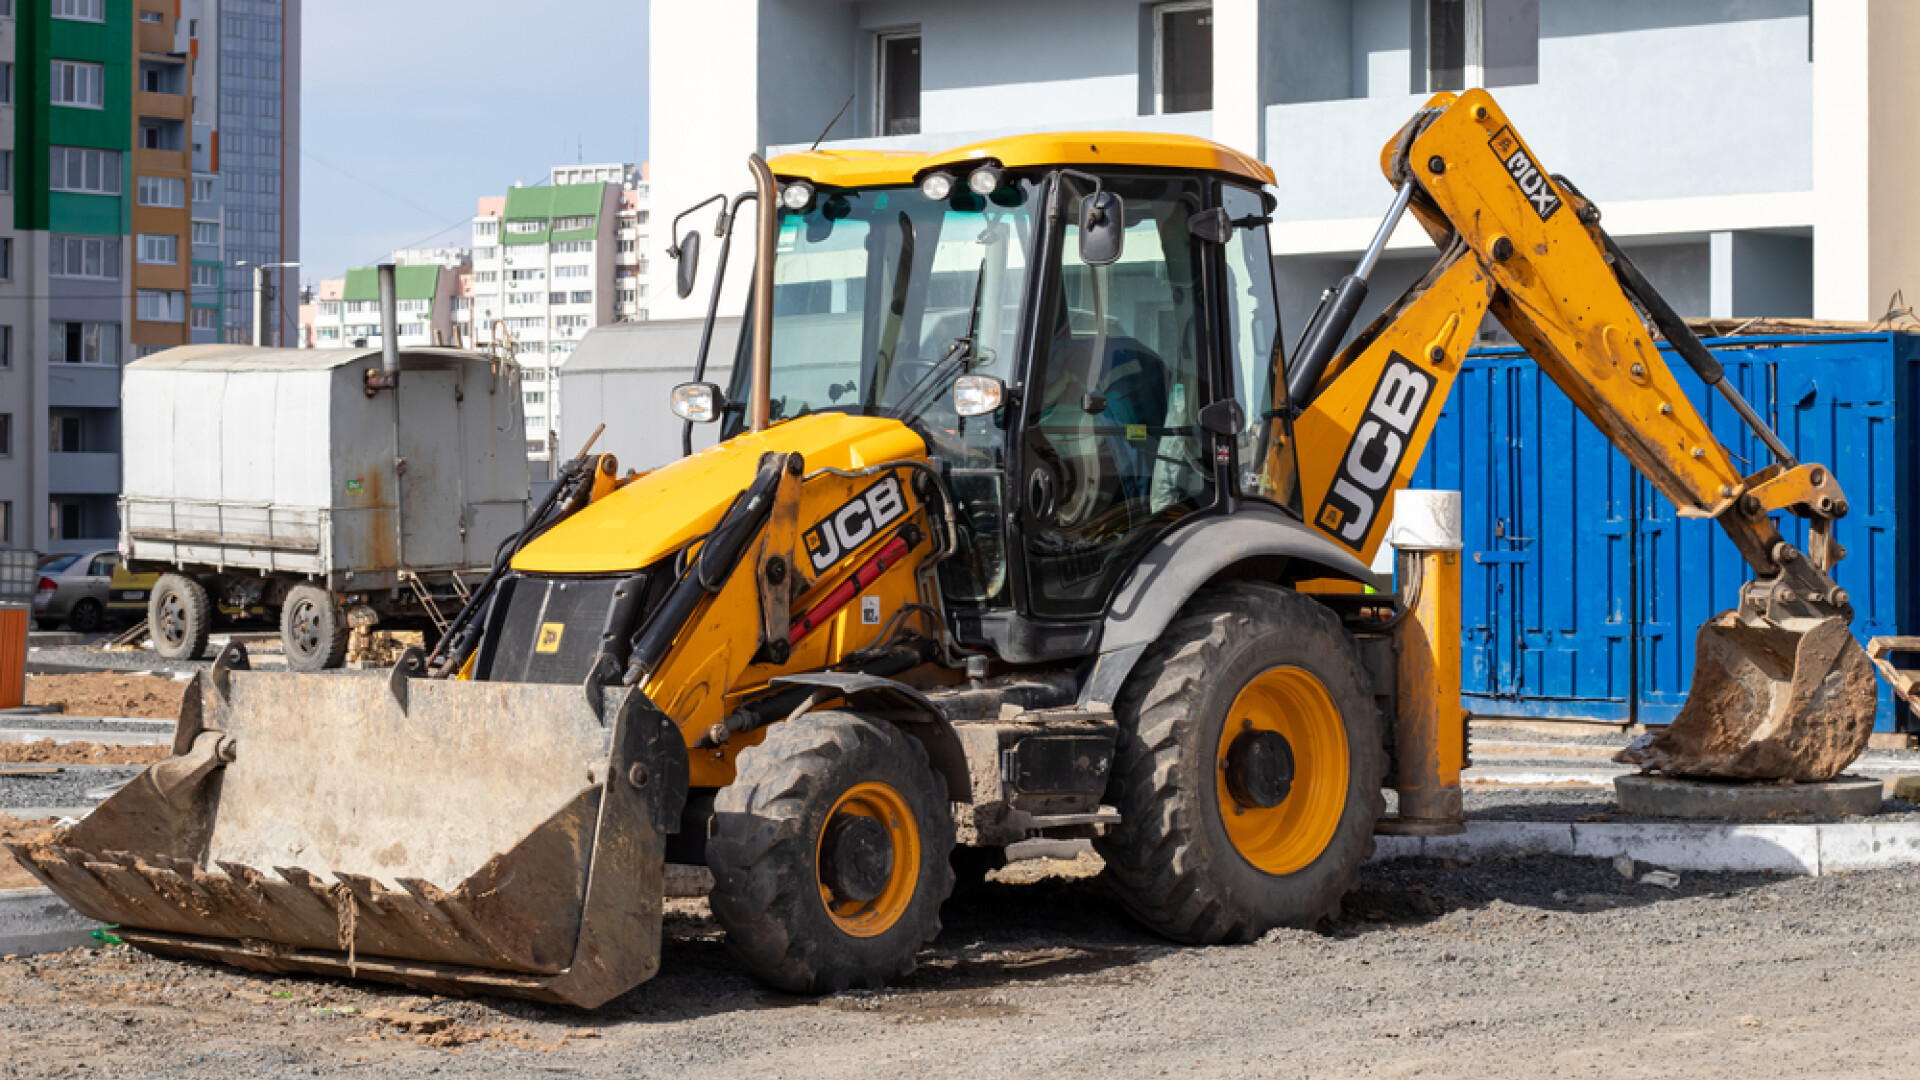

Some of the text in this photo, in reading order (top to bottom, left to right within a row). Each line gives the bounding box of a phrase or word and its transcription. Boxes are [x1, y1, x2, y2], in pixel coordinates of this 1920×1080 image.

[1506, 150, 1557, 215] 3CX
[1333, 362, 1430, 541] JCB
[812, 477, 903, 569] JCB
